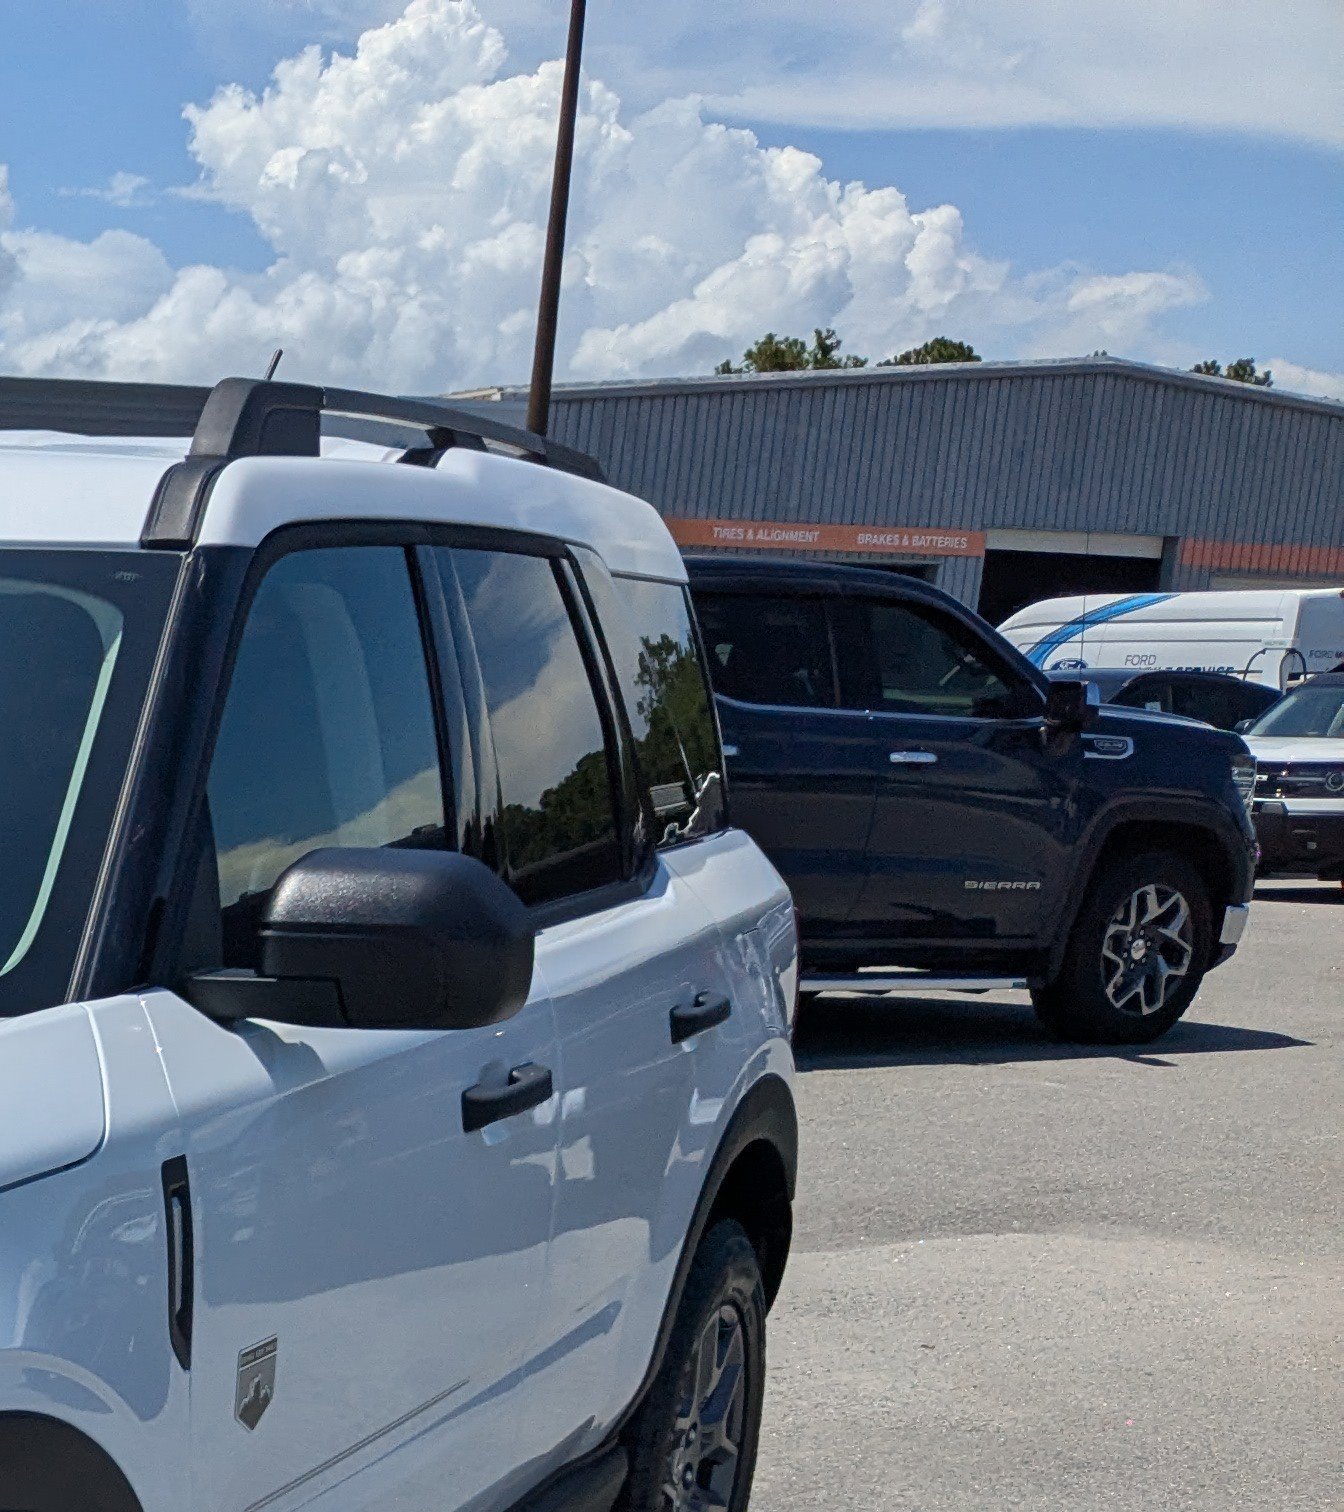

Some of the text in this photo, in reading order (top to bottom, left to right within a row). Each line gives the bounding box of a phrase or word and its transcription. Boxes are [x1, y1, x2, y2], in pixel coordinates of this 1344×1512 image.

[713, 527, 820, 543] TIRES & ALIGNMENT
[857, 533, 968, 549] BRAKES & BATTERIES
[1124, 654, 1157, 666] FORD
[963, 880, 1042, 890] SIERRA
